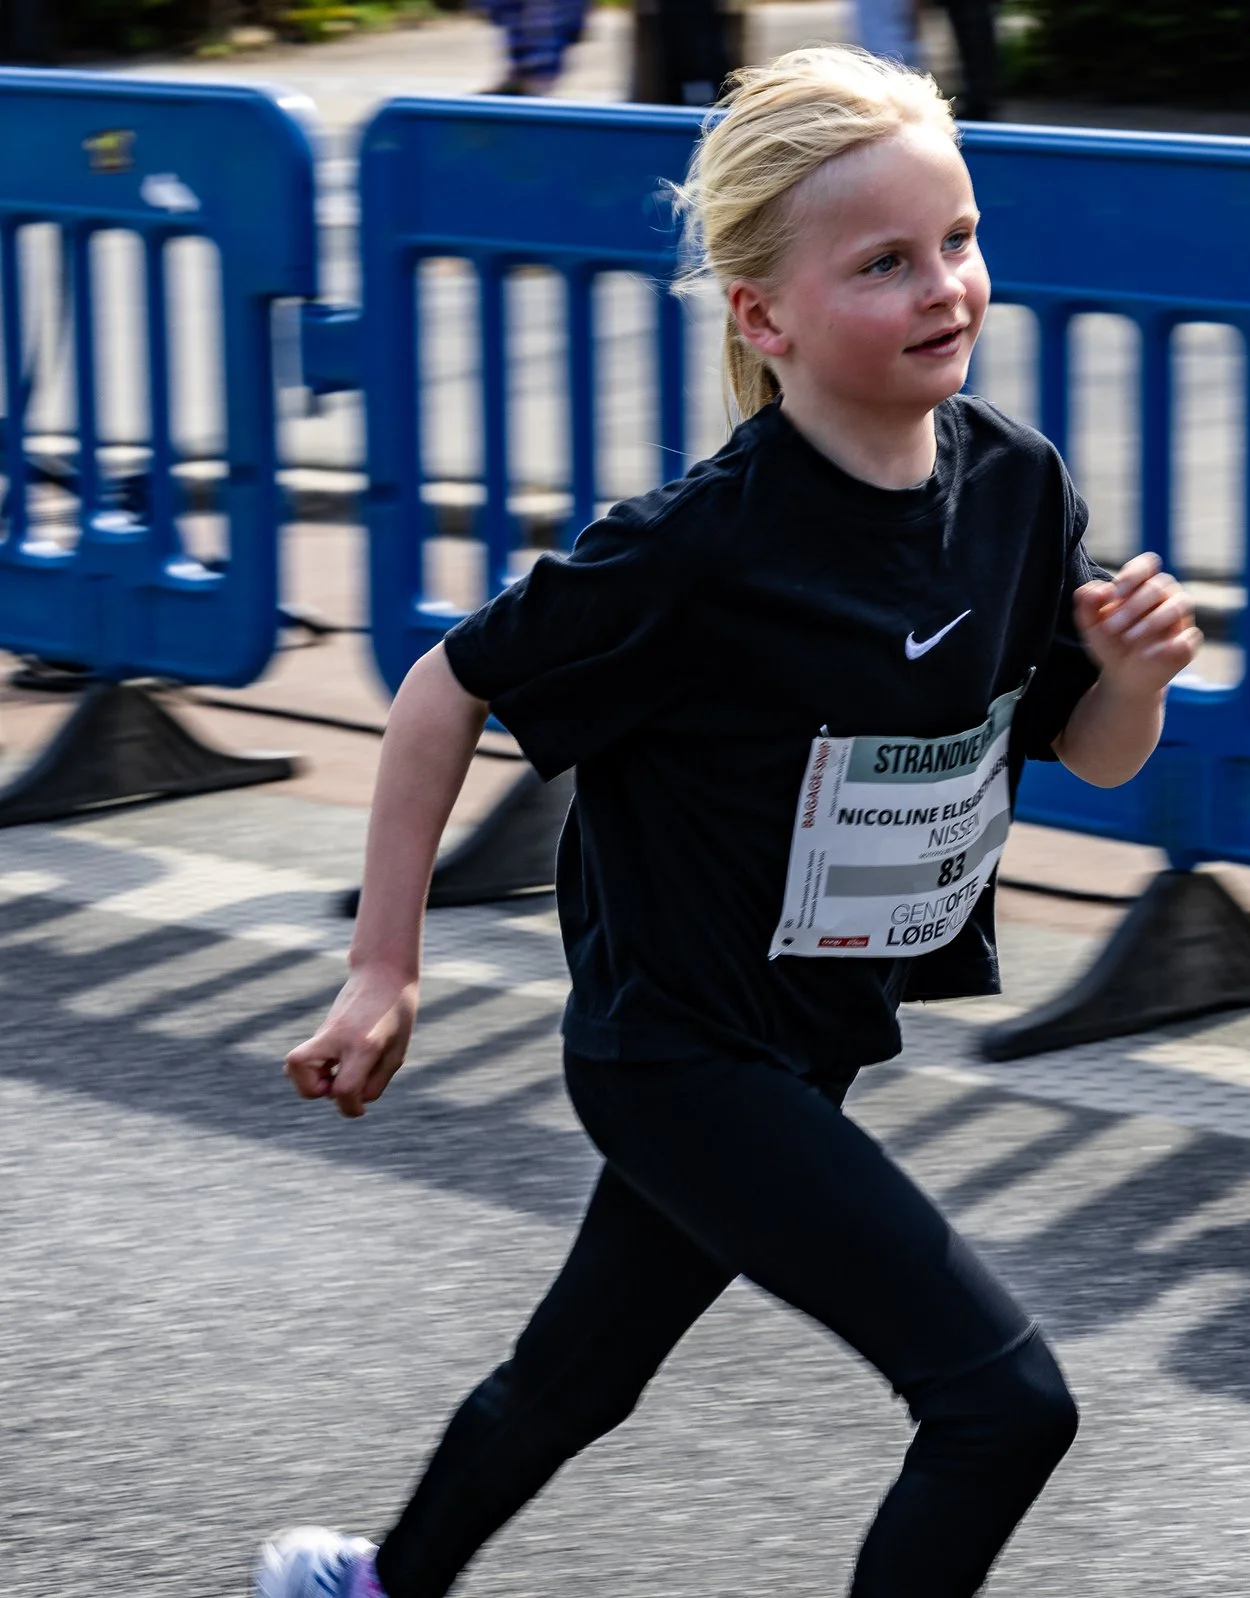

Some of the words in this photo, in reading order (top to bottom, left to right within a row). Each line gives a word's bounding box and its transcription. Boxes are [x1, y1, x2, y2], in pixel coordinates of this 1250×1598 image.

[837, 806, 940, 826] NICOLINE
[937, 851, 967, 887] 83
[890, 876, 979, 925] GENTOFTE
